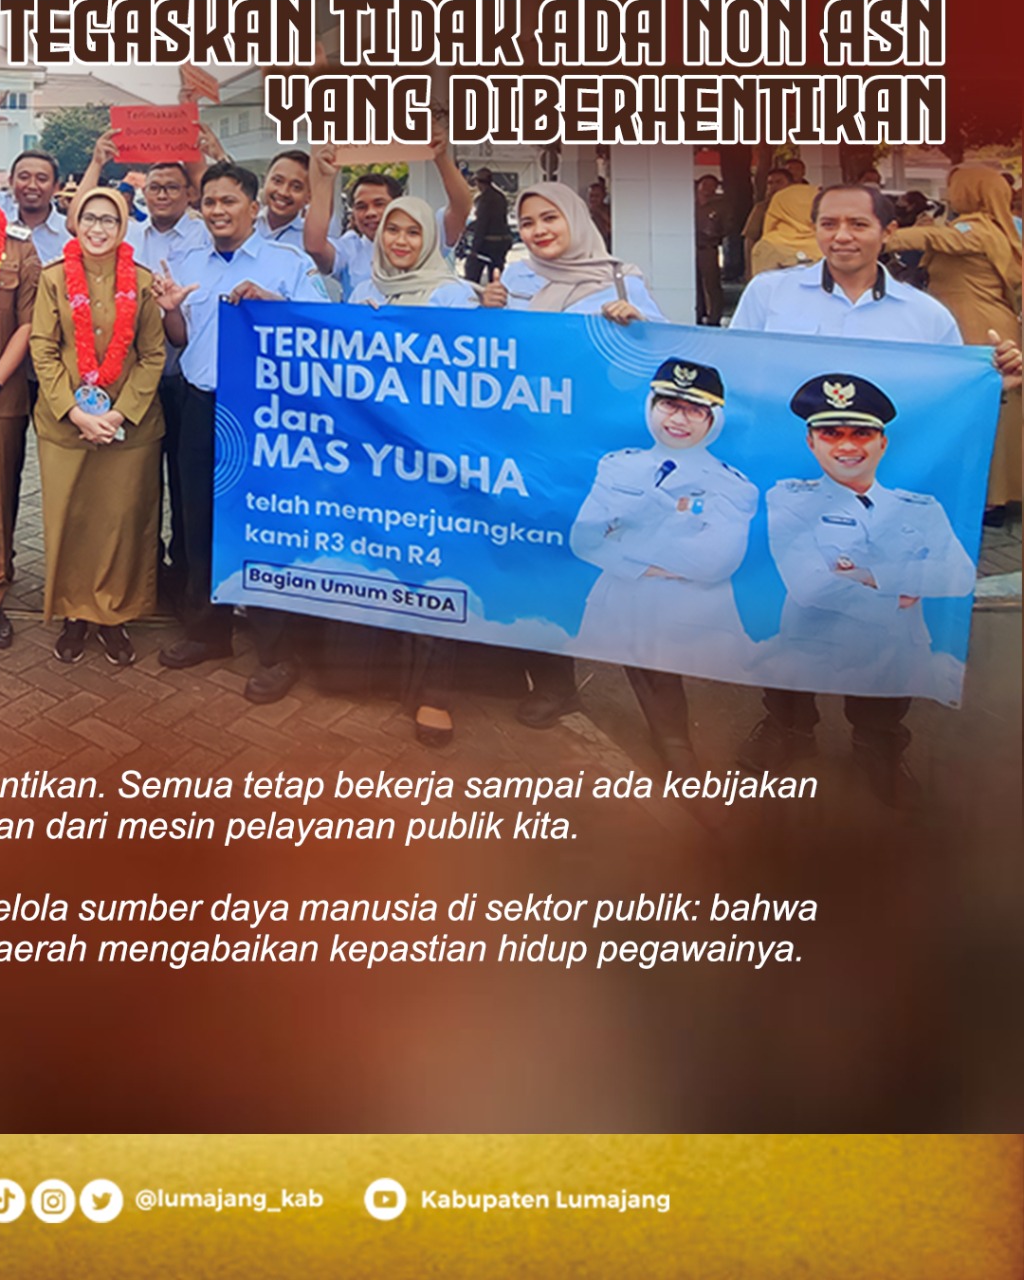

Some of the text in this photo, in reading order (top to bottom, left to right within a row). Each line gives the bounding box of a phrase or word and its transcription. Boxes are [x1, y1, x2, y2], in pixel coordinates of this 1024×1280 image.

[253, 325, 517, 370] TERIMAKASIH
[255, 356, 573, 415] BUNDA INDAH
[253, 394, 335, 435] dan
[252, 433, 529, 498] MAS YUDHA
[245, 492, 564, 546] telah memperjuangkan
[244, 523, 442, 567] kami R3 dan R4
[248, 568, 456, 613] Bagian Umum SETDA
